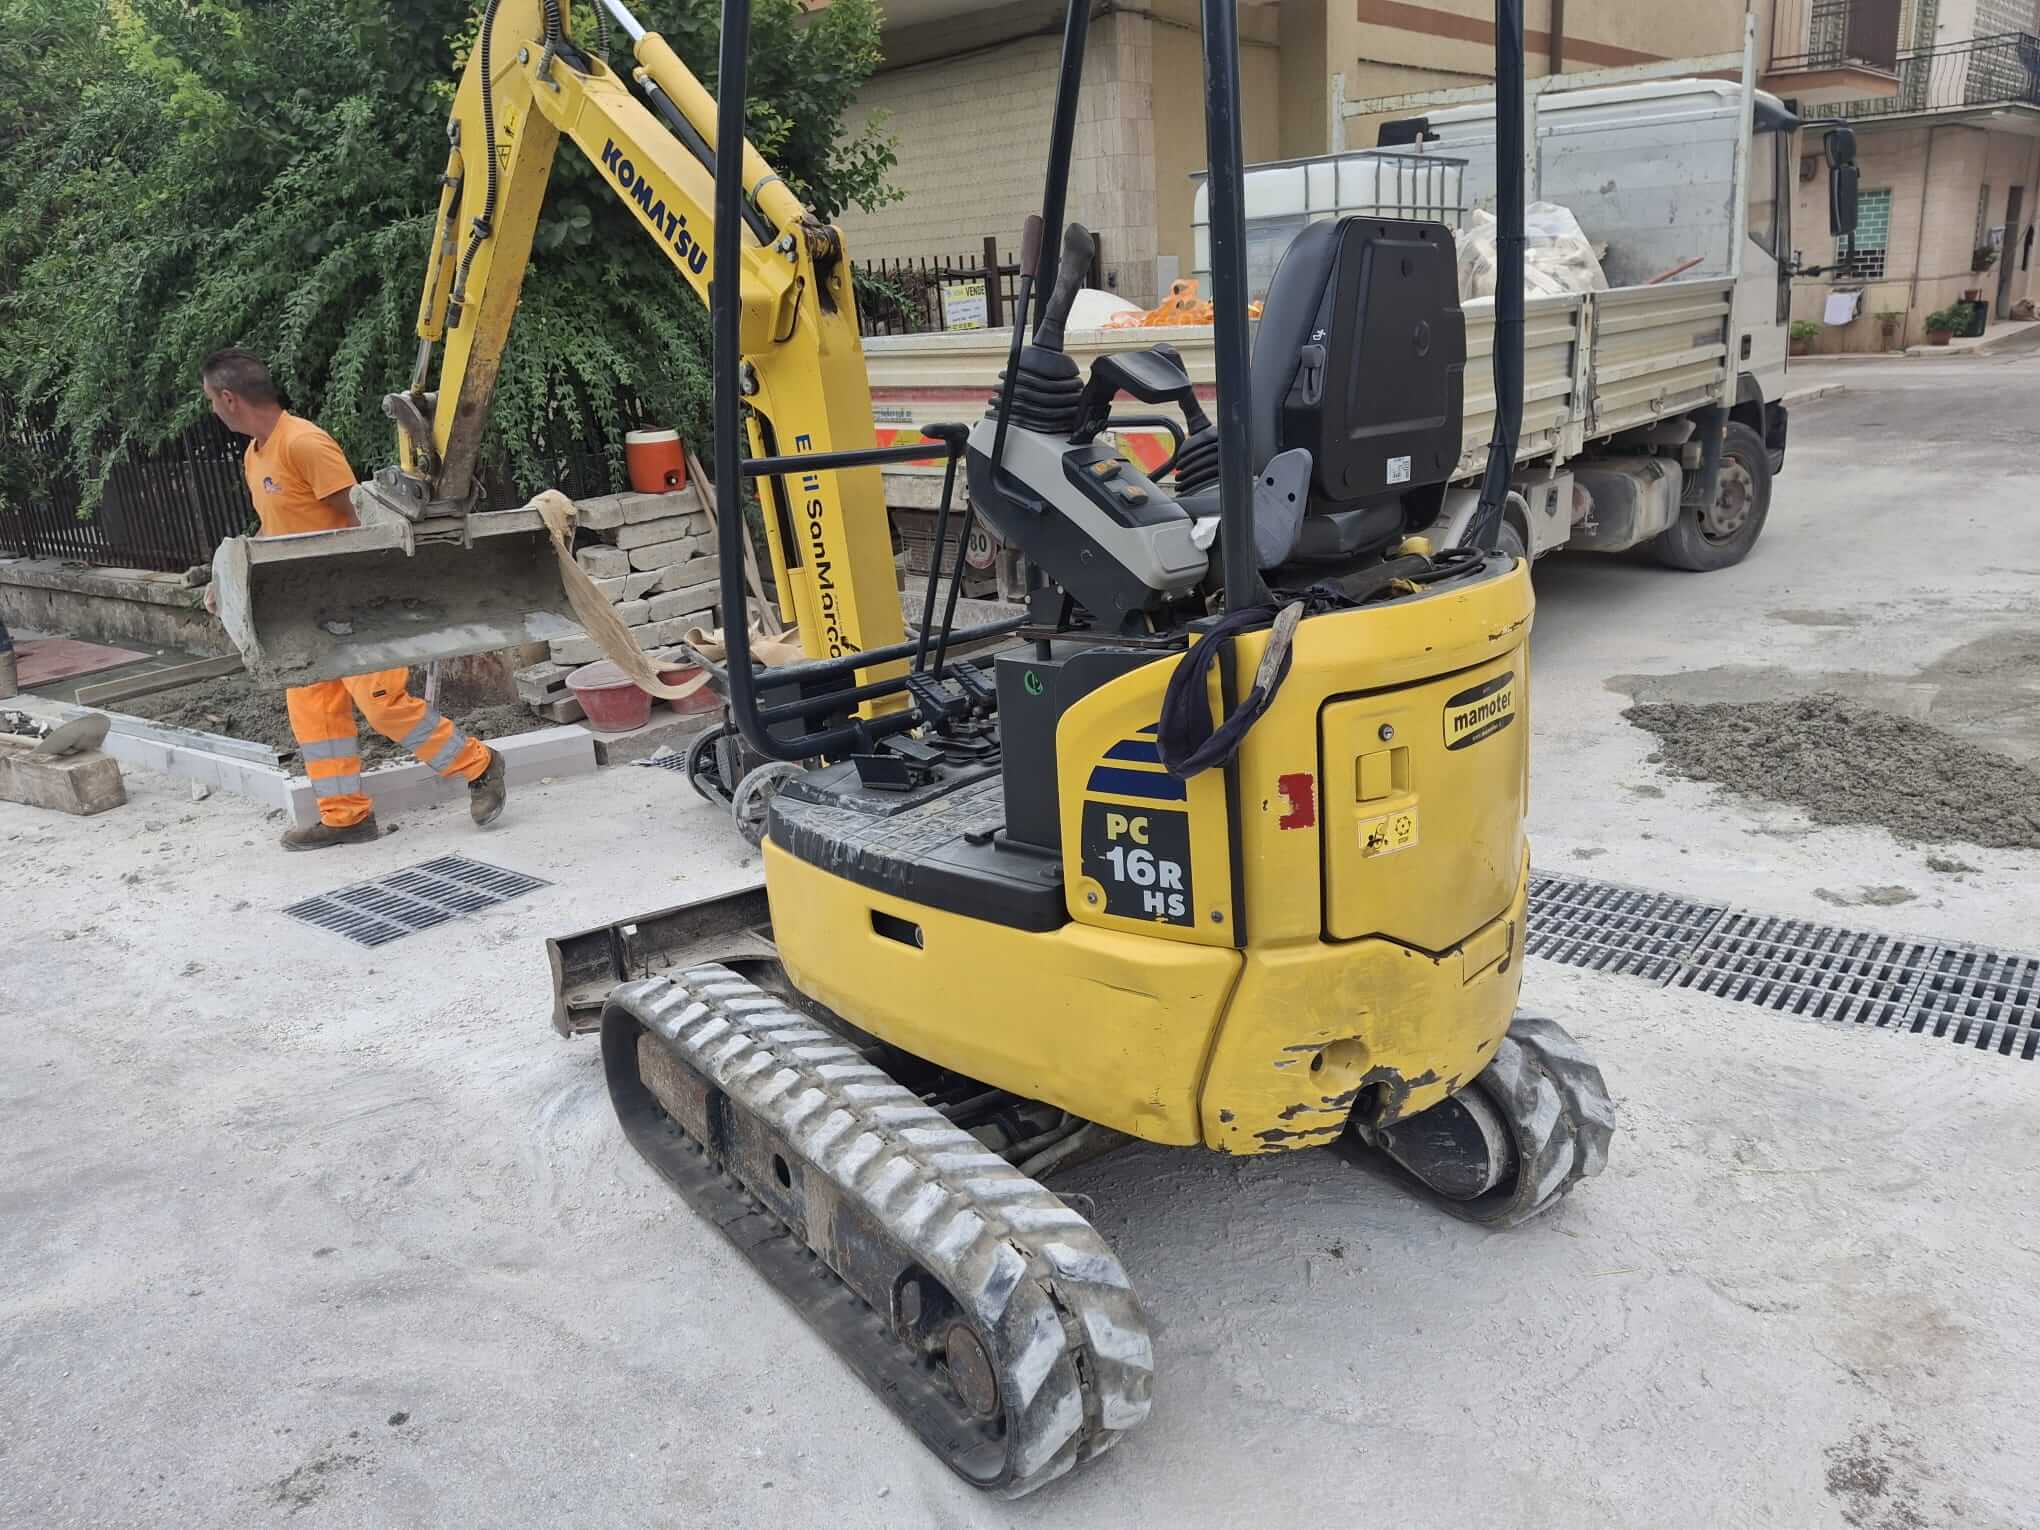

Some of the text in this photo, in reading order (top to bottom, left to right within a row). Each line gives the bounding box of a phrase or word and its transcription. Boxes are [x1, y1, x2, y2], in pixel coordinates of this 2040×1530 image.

[601, 137, 708, 274] KOMATSU
[795, 433, 841, 658] Eil SanMarco
[970, 534, 987, 552] 80
[1454, 691, 1511, 732] mamoter
[1106, 813, 1149, 845] PC
[1106, 846, 1184, 890] 16R
[1143, 890, 1185, 917] HS
